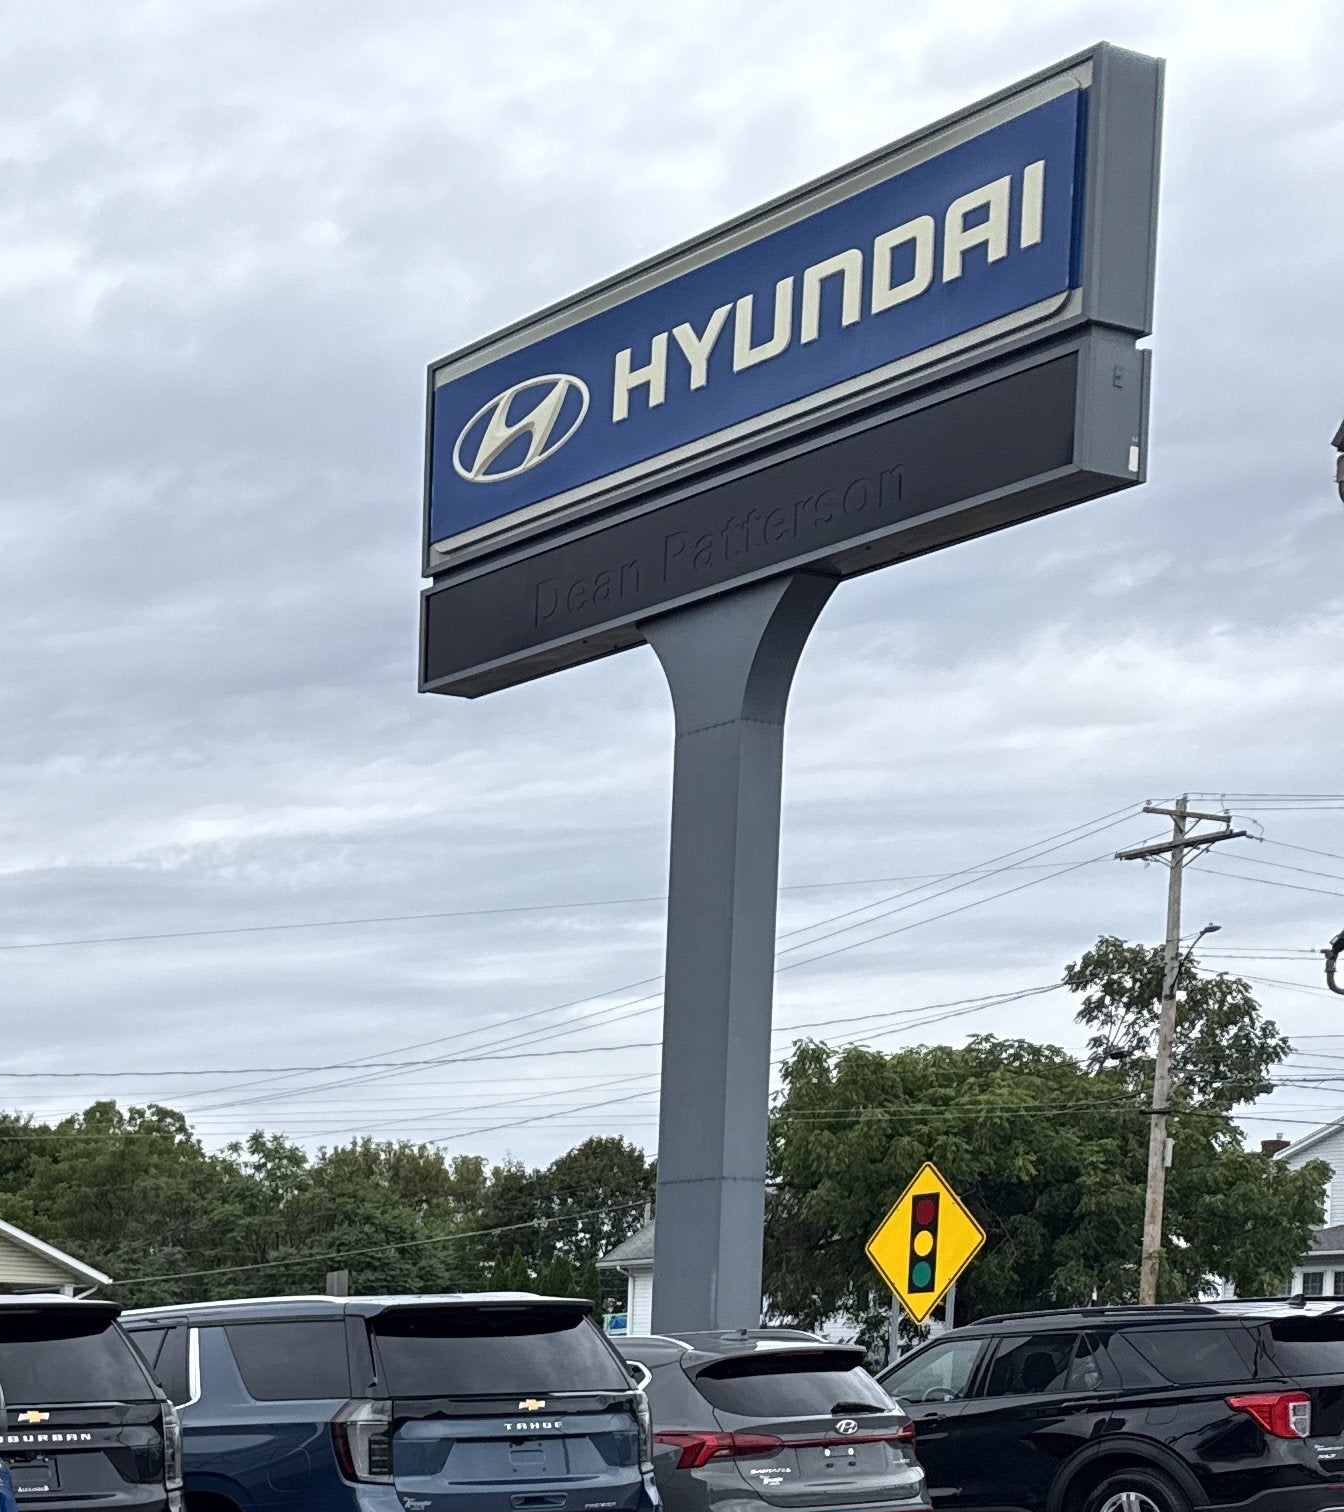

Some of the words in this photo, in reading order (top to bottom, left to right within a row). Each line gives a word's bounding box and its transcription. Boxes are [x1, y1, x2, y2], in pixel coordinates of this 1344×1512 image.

[612, 158, 1046, 423] HYUNDAI
[533, 557, 640, 627] Dean
[662, 462, 904, 583] Patterson
